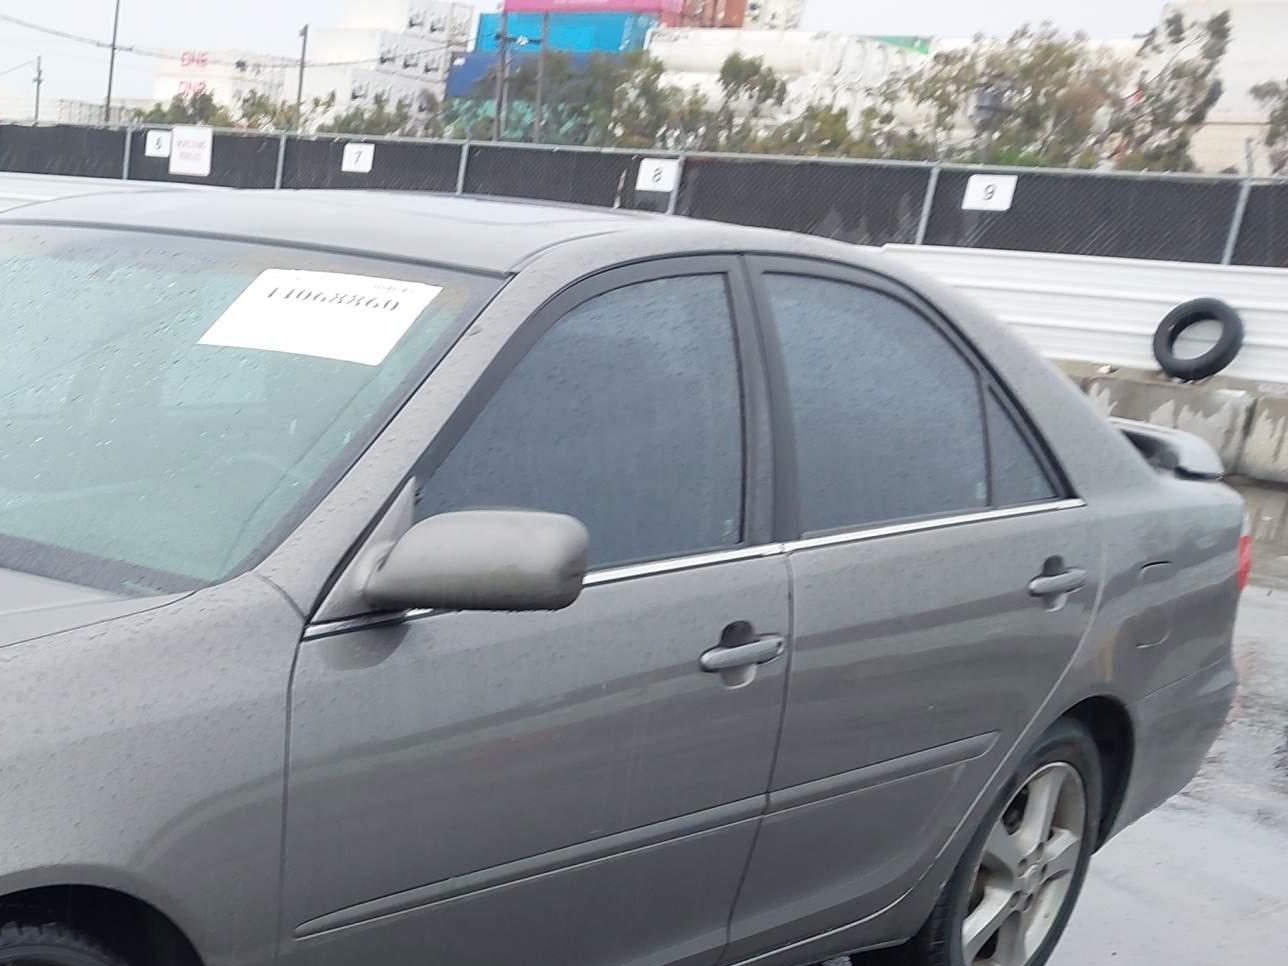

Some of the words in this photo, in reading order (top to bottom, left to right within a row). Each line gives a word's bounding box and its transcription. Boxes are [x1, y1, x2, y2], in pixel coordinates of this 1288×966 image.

[353, 150, 363, 165] 7
[651, 166, 664, 183] 8
[982, 183, 998, 200] 9
